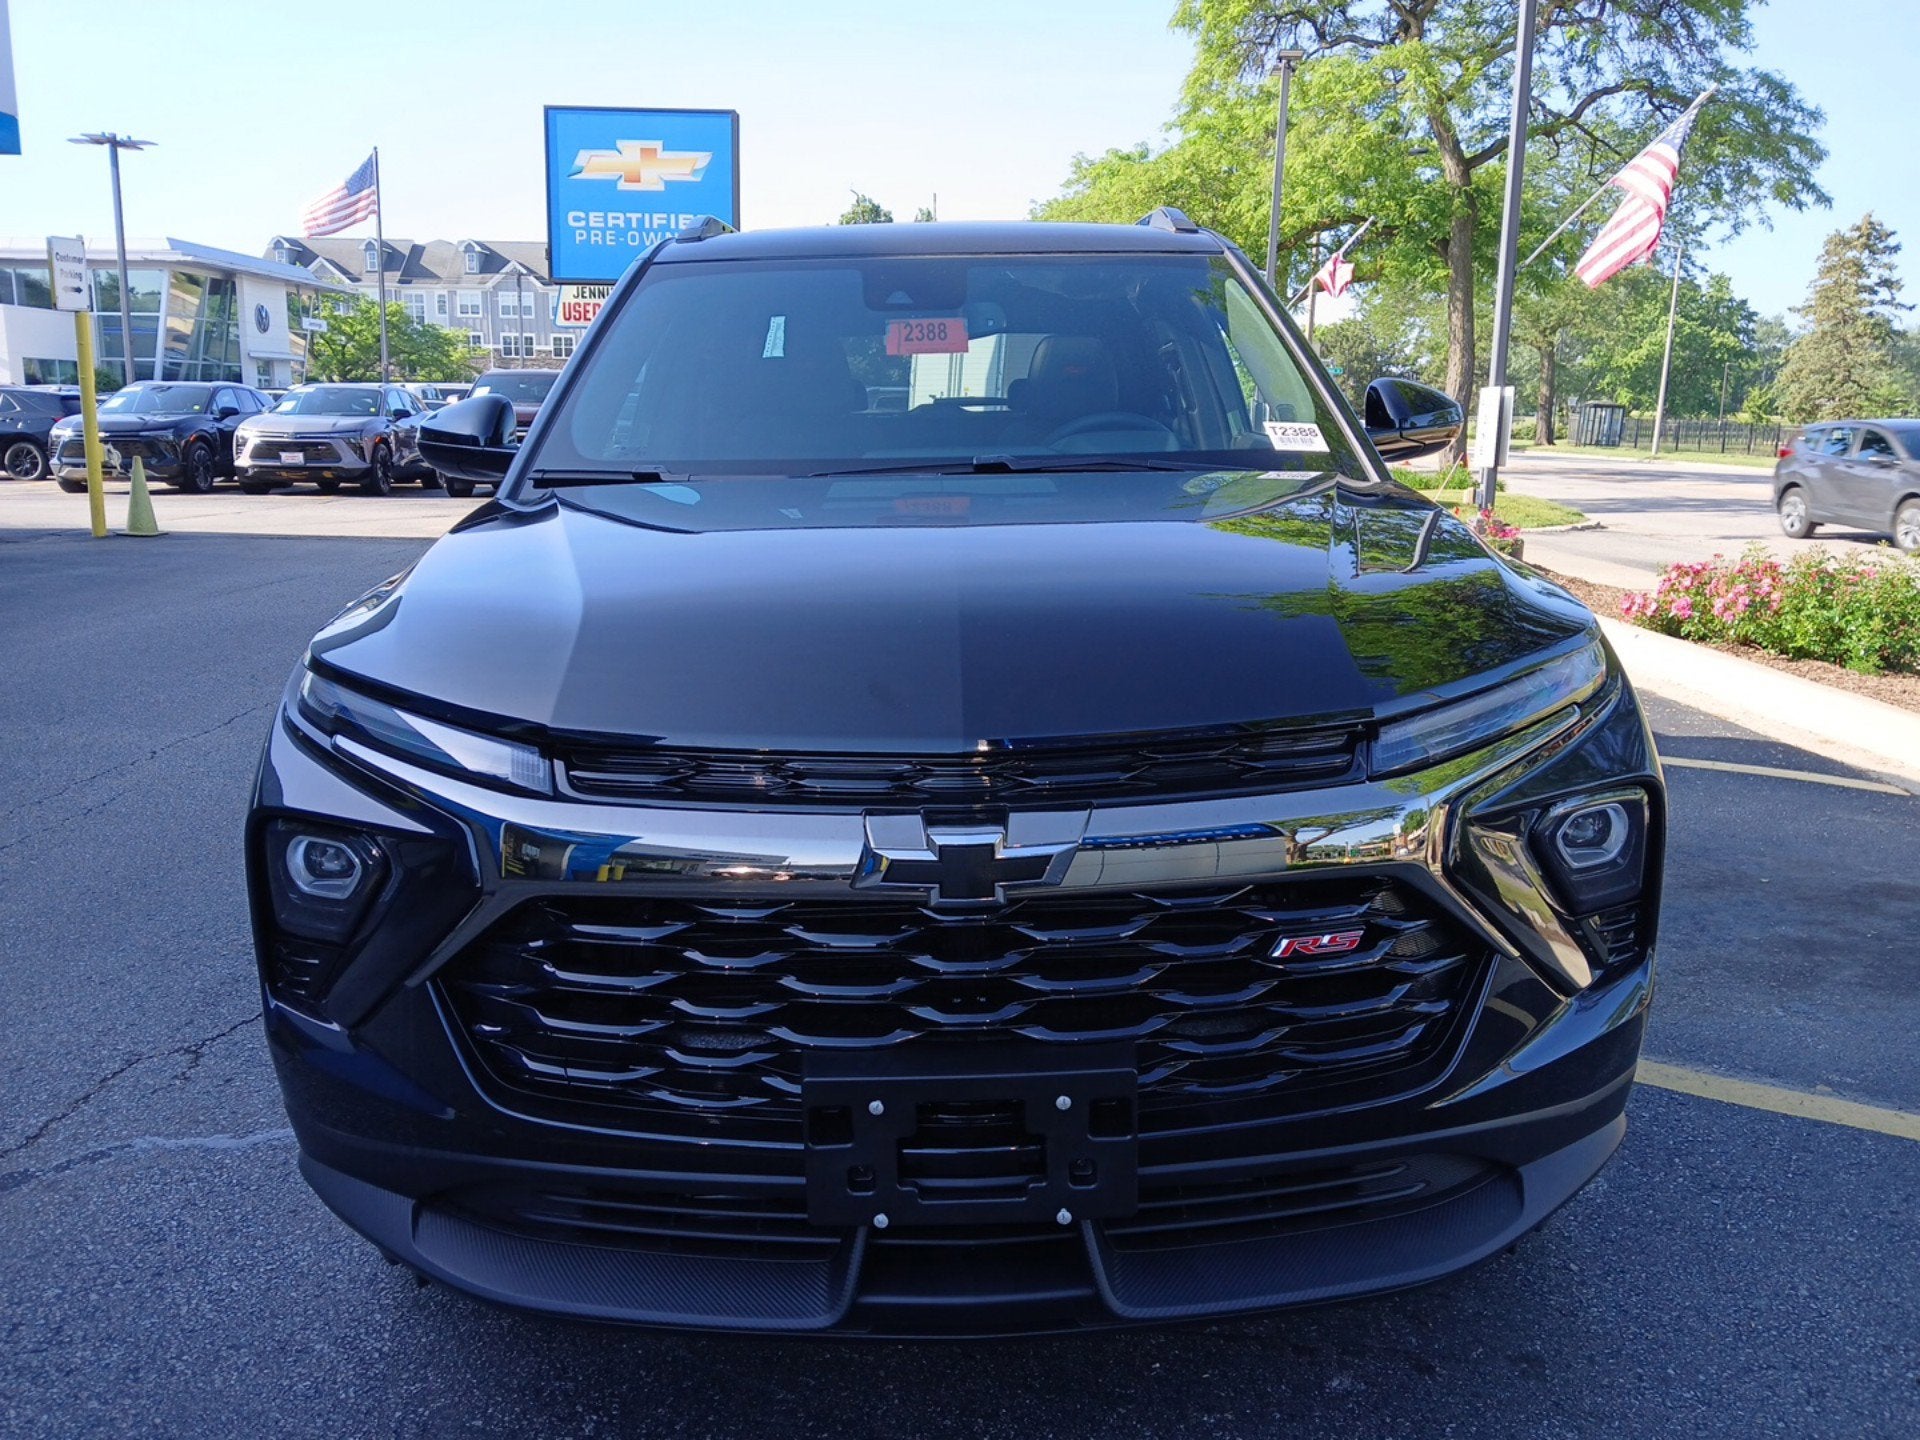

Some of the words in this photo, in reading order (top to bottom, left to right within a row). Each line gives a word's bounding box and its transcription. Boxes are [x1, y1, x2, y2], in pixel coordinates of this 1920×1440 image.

[567, 210, 706, 230] CERTIFIE
[572, 286, 613, 299] JENNI
[904, 322, 947, 342] 2388
[1269, 426, 1319, 437] T2388
[1271, 930, 1364, 957] RS
